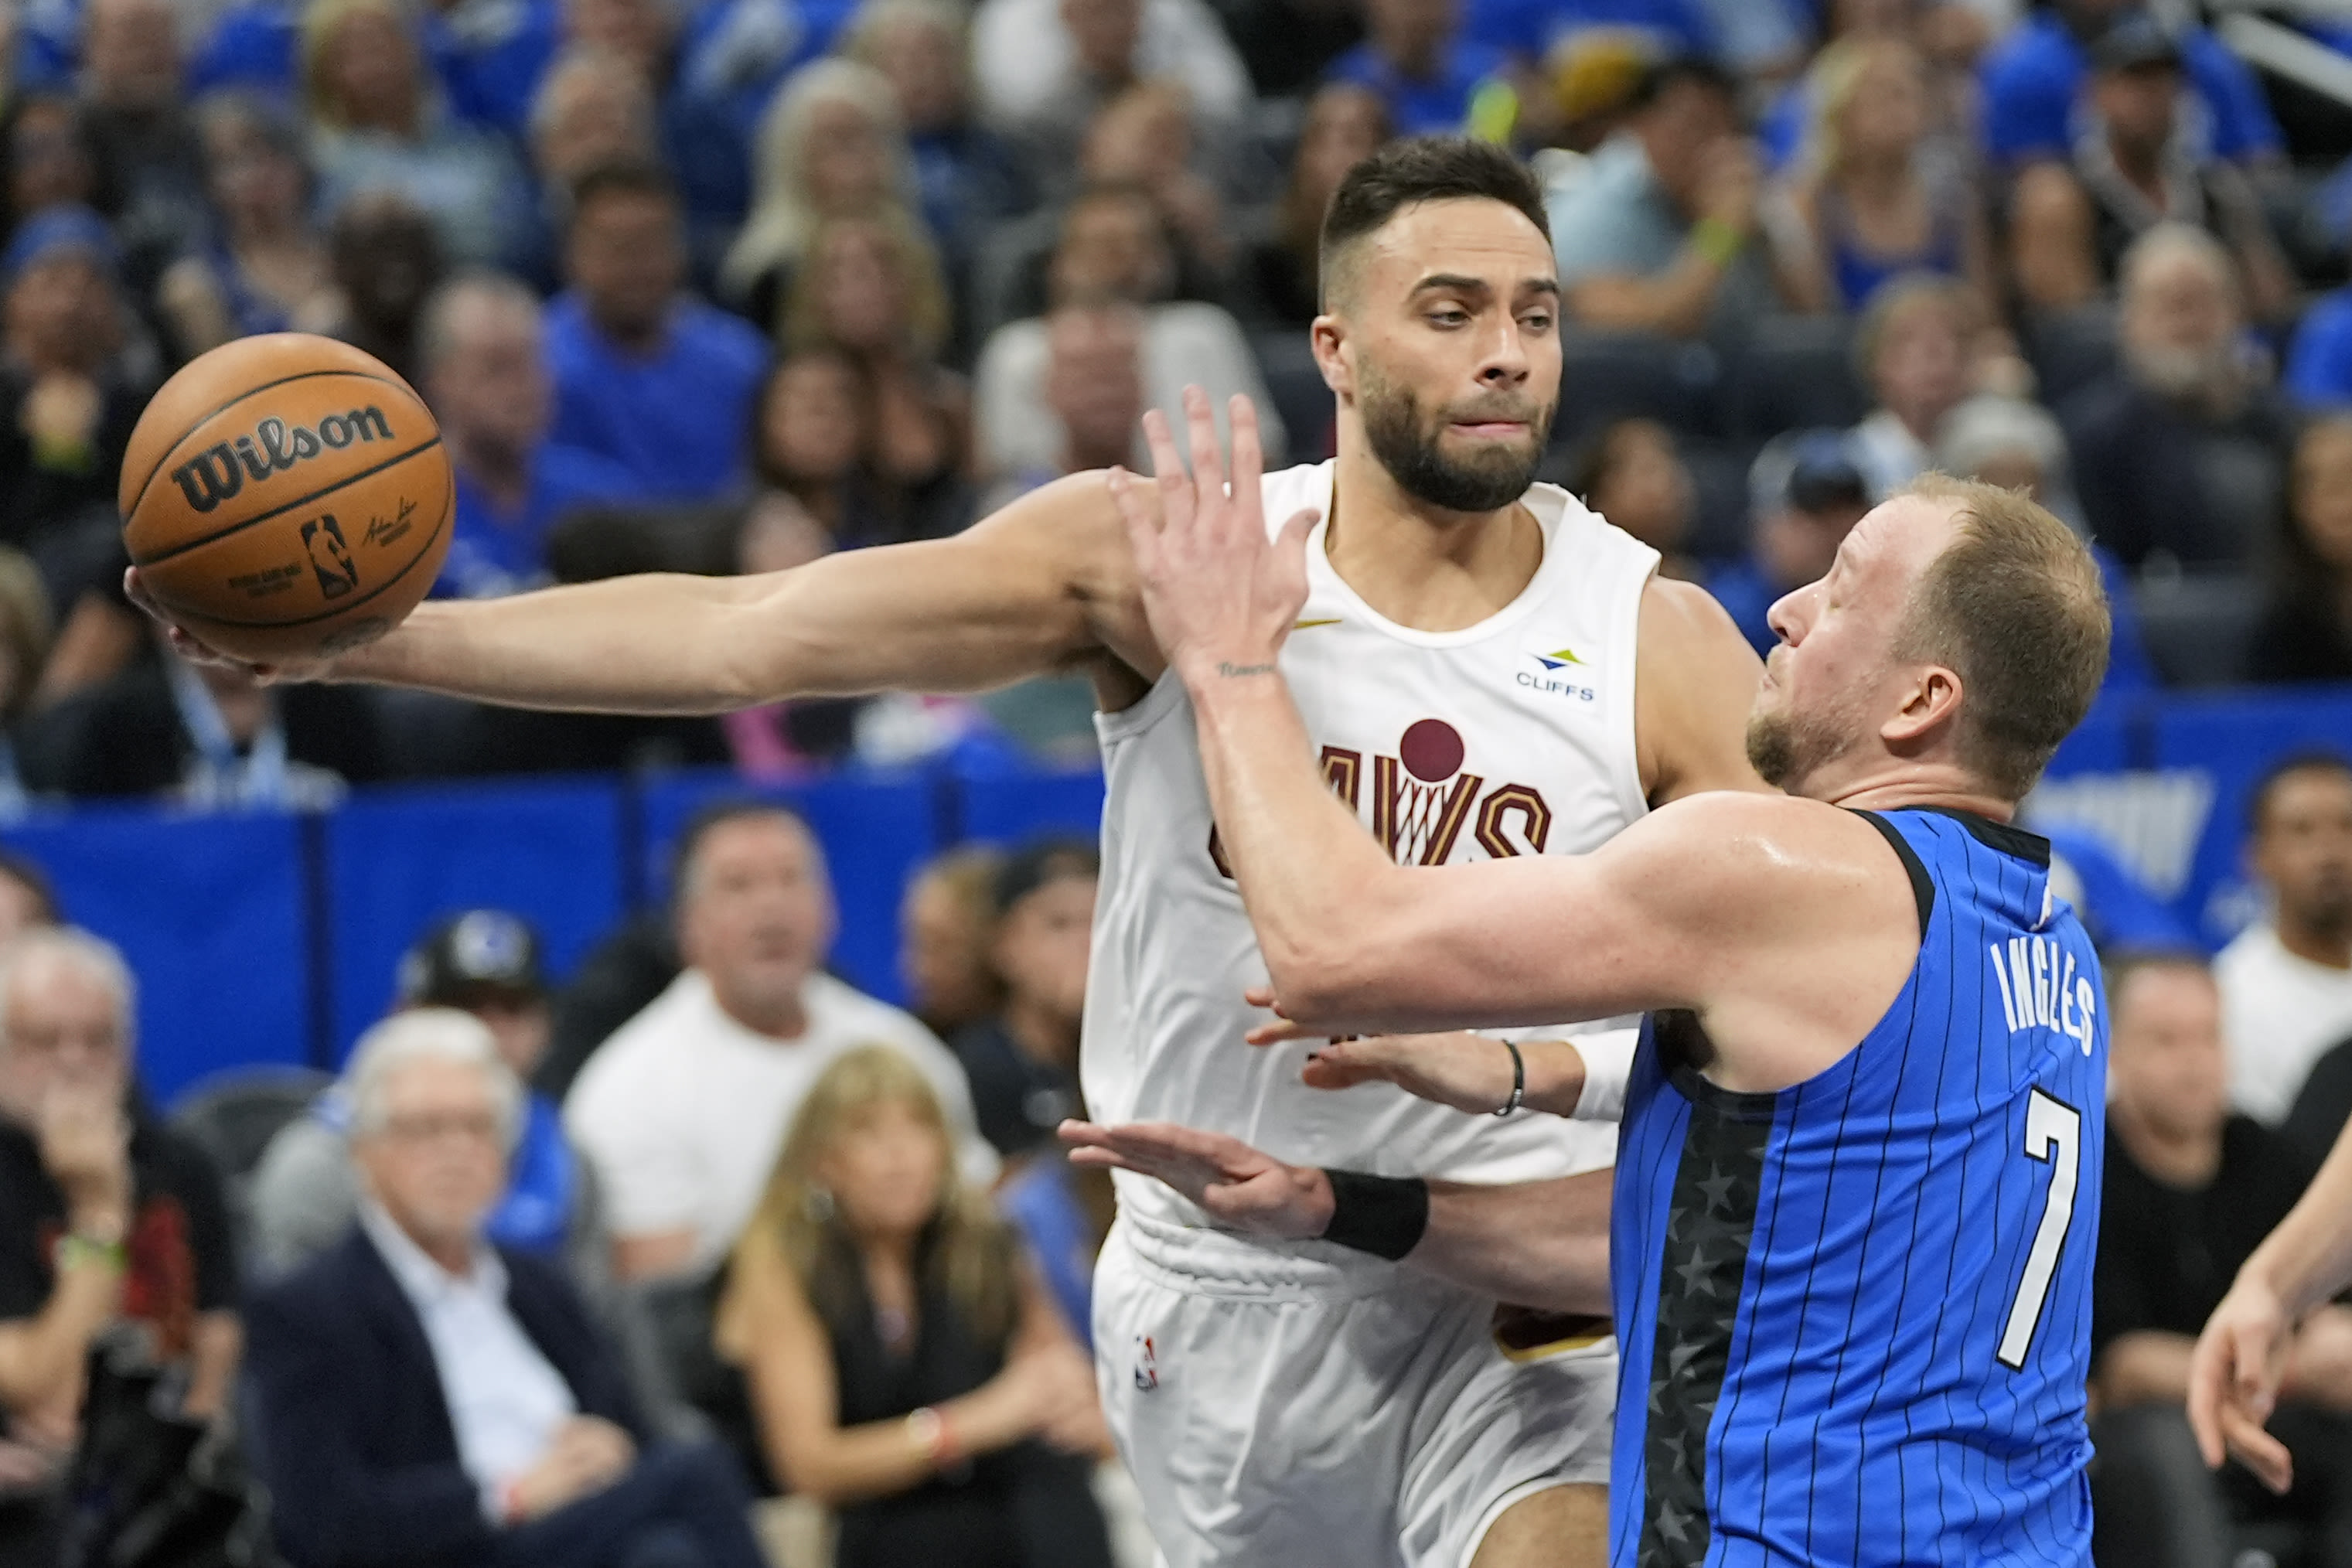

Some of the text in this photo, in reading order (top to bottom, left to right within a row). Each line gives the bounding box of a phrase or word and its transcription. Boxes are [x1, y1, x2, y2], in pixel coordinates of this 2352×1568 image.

[172, 405, 394, 513] Wilson
[1516, 672, 1594, 701] CLIFFS
[1990, 935, 2095, 1058] INGLES
[1996, 1086, 2081, 1372] 7
